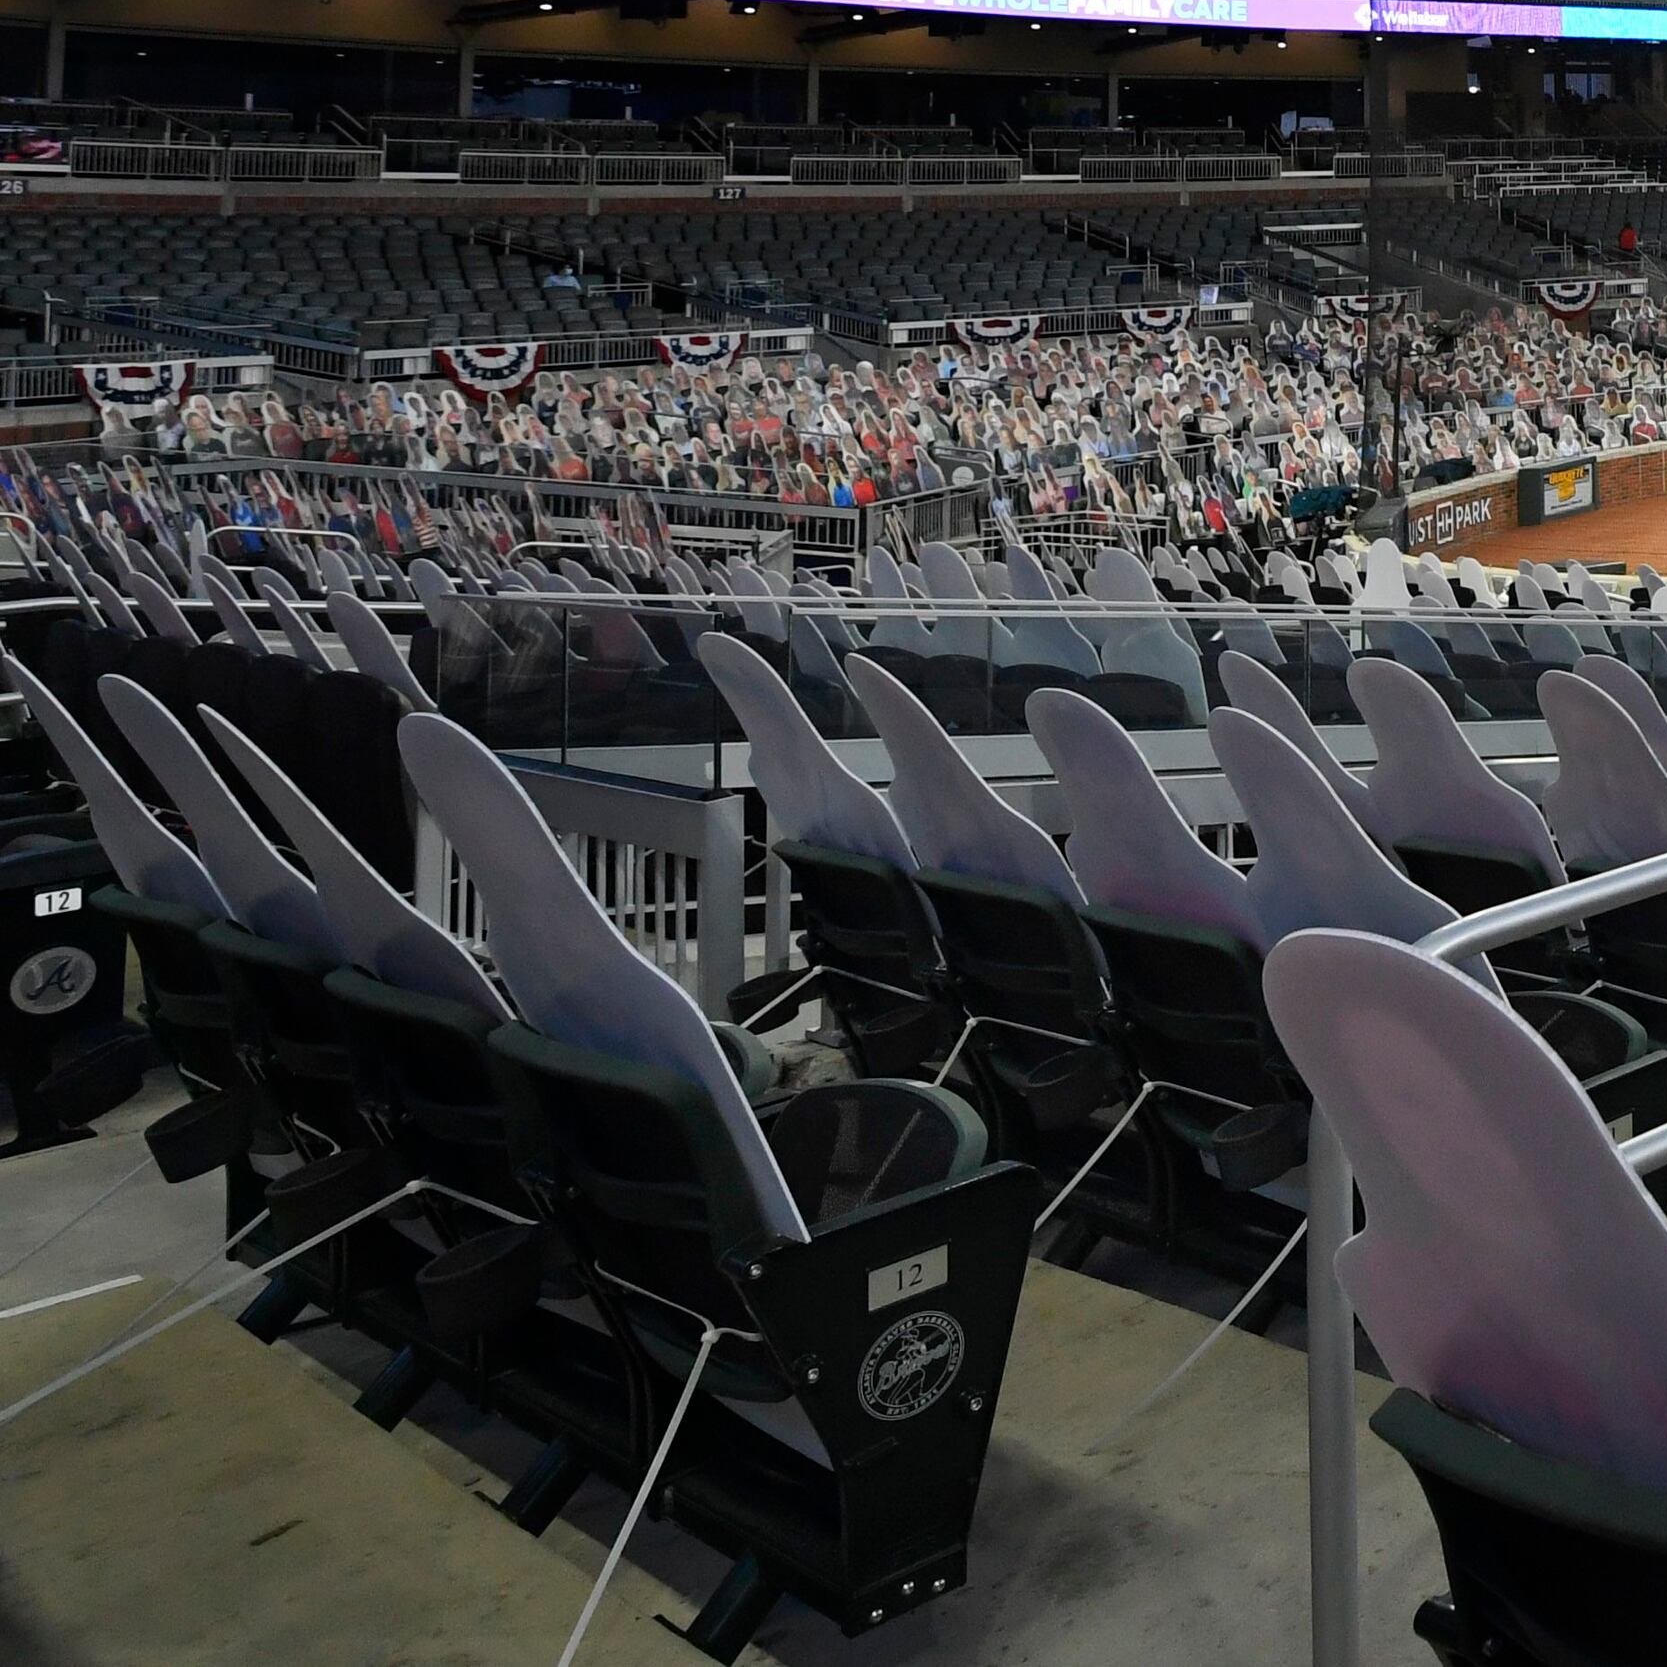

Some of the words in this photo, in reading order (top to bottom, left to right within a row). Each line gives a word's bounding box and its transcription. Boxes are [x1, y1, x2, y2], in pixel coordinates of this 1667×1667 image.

[717, 187, 743, 200] 127
[1456, 497, 1493, 530] PARK
[45, 891, 70, 913] 12
[896, 1263, 923, 1292] 12
